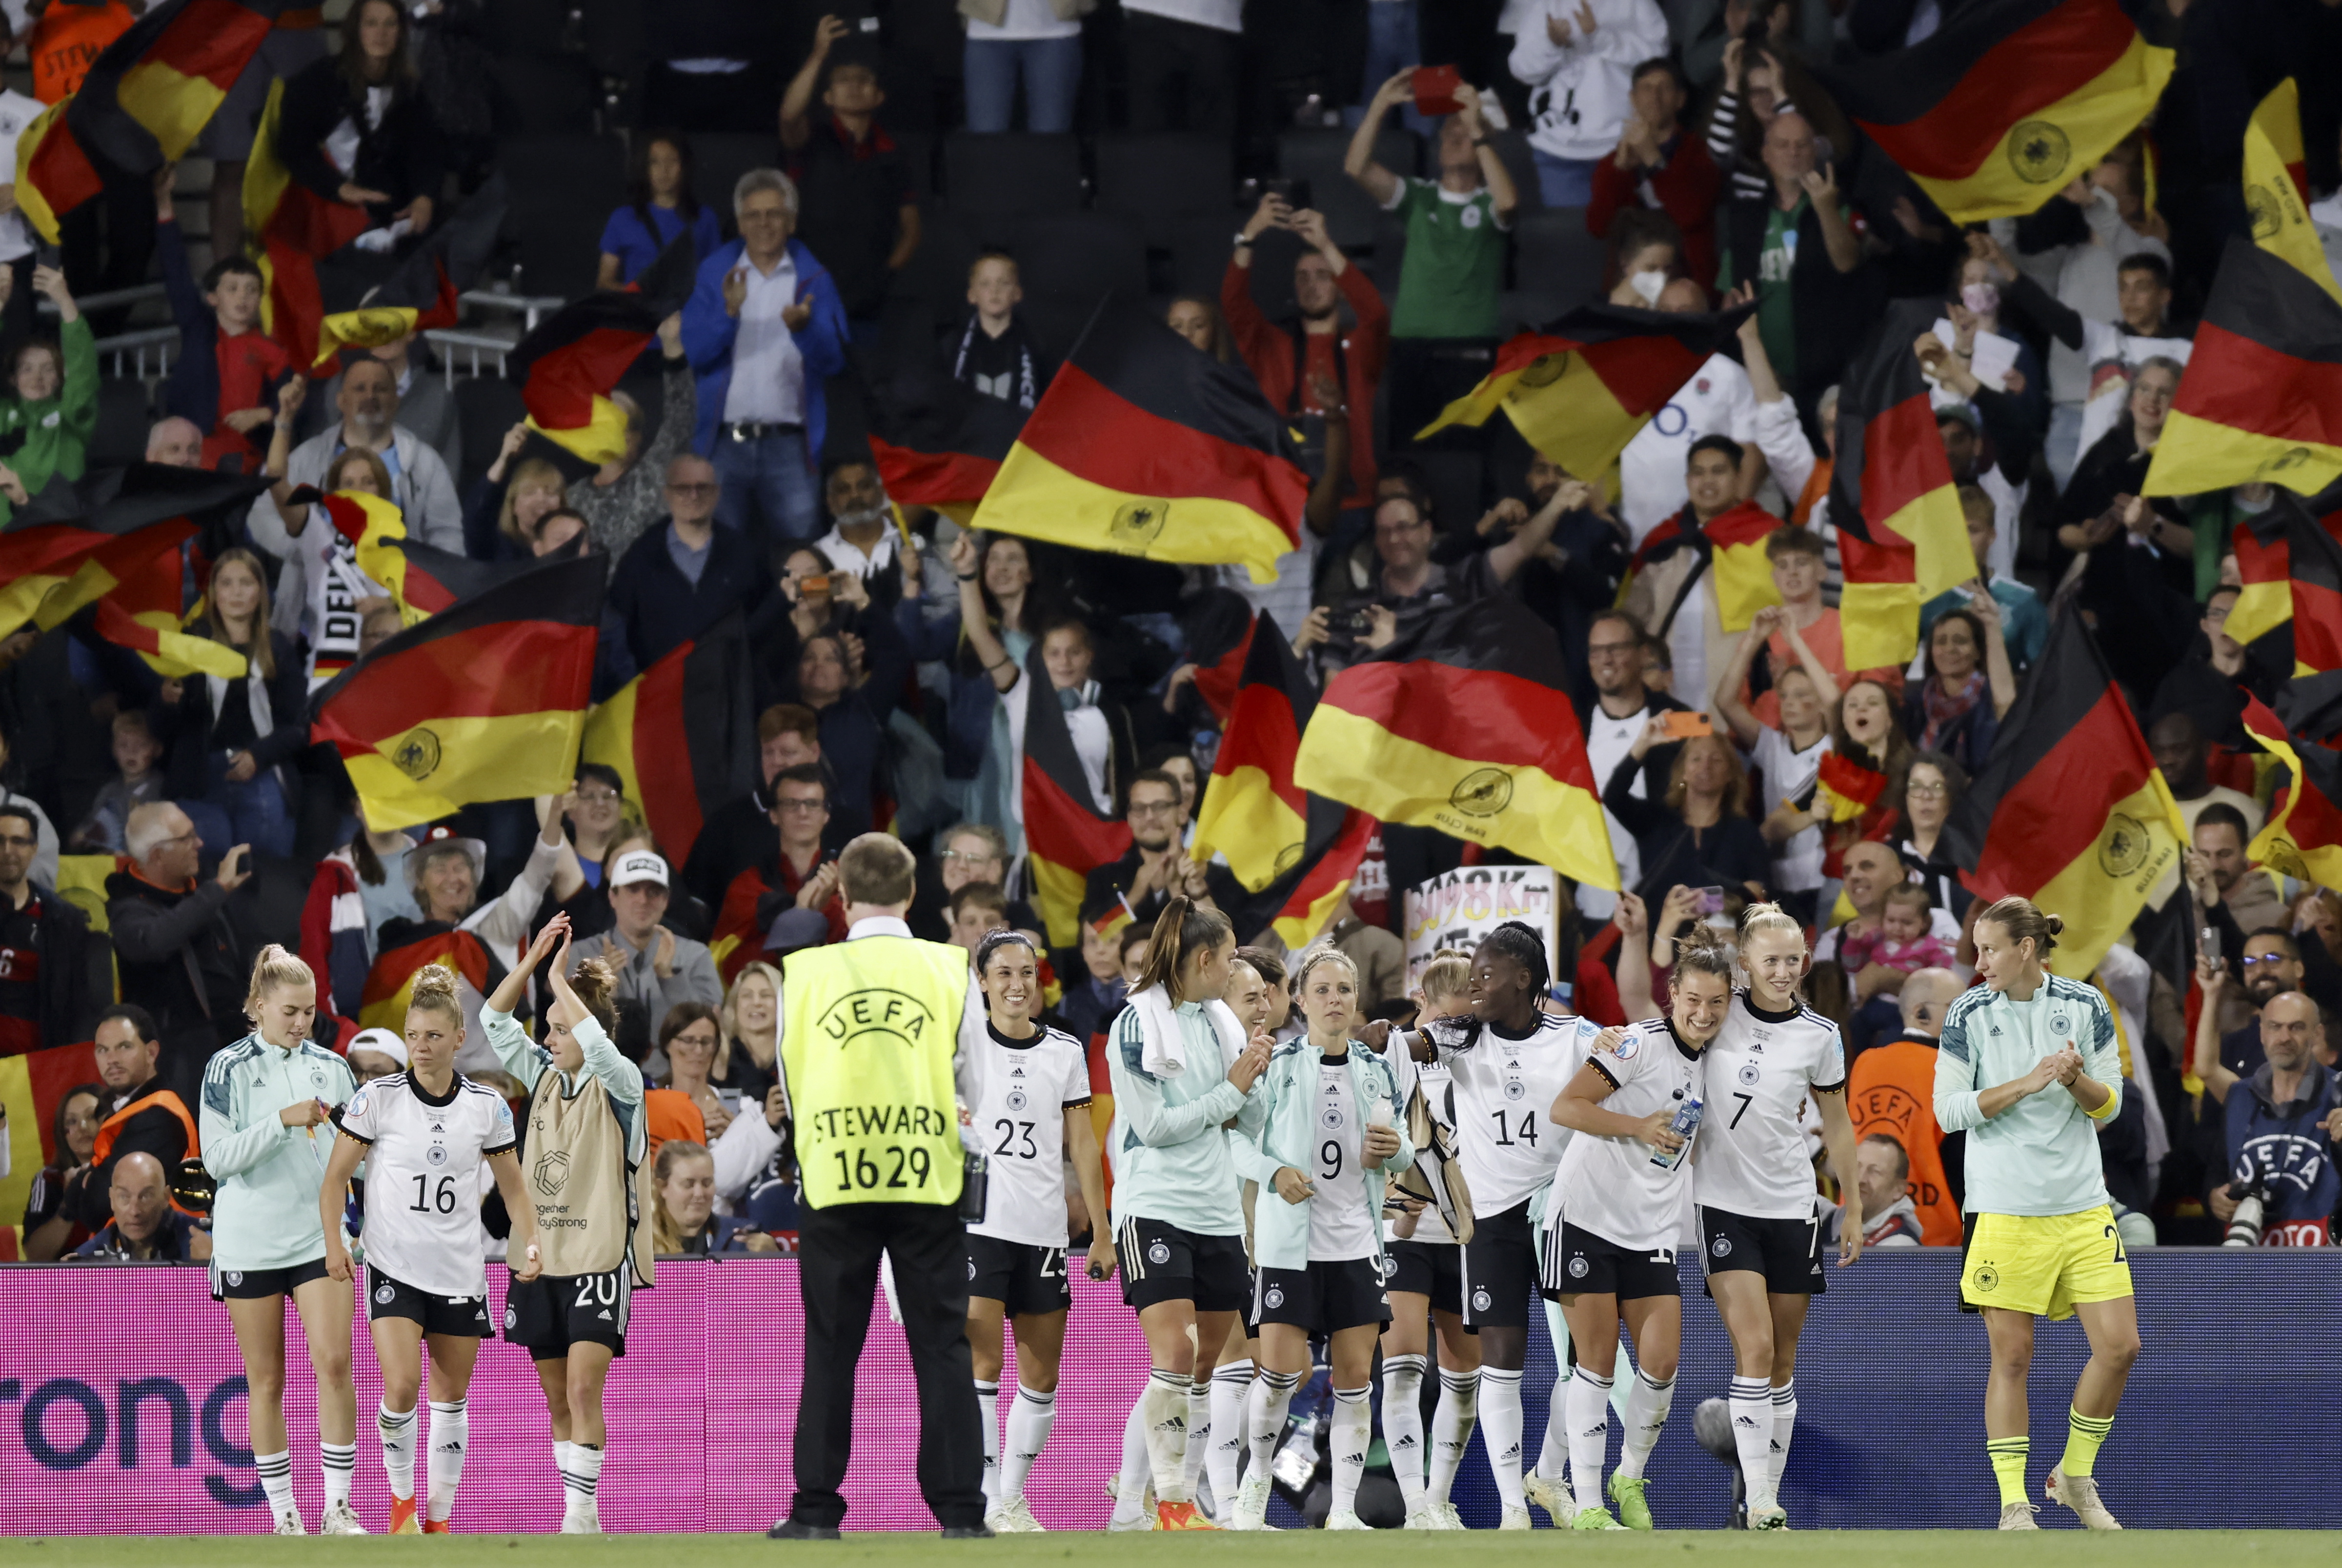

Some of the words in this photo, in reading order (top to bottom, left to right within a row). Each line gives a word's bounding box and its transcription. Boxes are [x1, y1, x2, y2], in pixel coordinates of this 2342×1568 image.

[45, 42, 107, 78] STEW
[825, 998, 924, 1040] UEFA
[814, 1105, 946, 1143] STEWARD
[1492, 1109, 1538, 1147] 14
[1729, 1091, 1754, 1130] 7
[993, 1118, 1037, 1159] 23
[1321, 1140, 1343, 1180] 9
[2236, 1144, 2321, 1184] UEFA
[410, 1173, 456, 1214] 16
[538, 1217, 587, 1230] layStrong
[1805, 1216, 1818, 1259] 7
[1369, 1254, 1386, 1287] 9
[575, 1273, 617, 1307] 20
[1392, 1442, 1418, 1451] adidas
